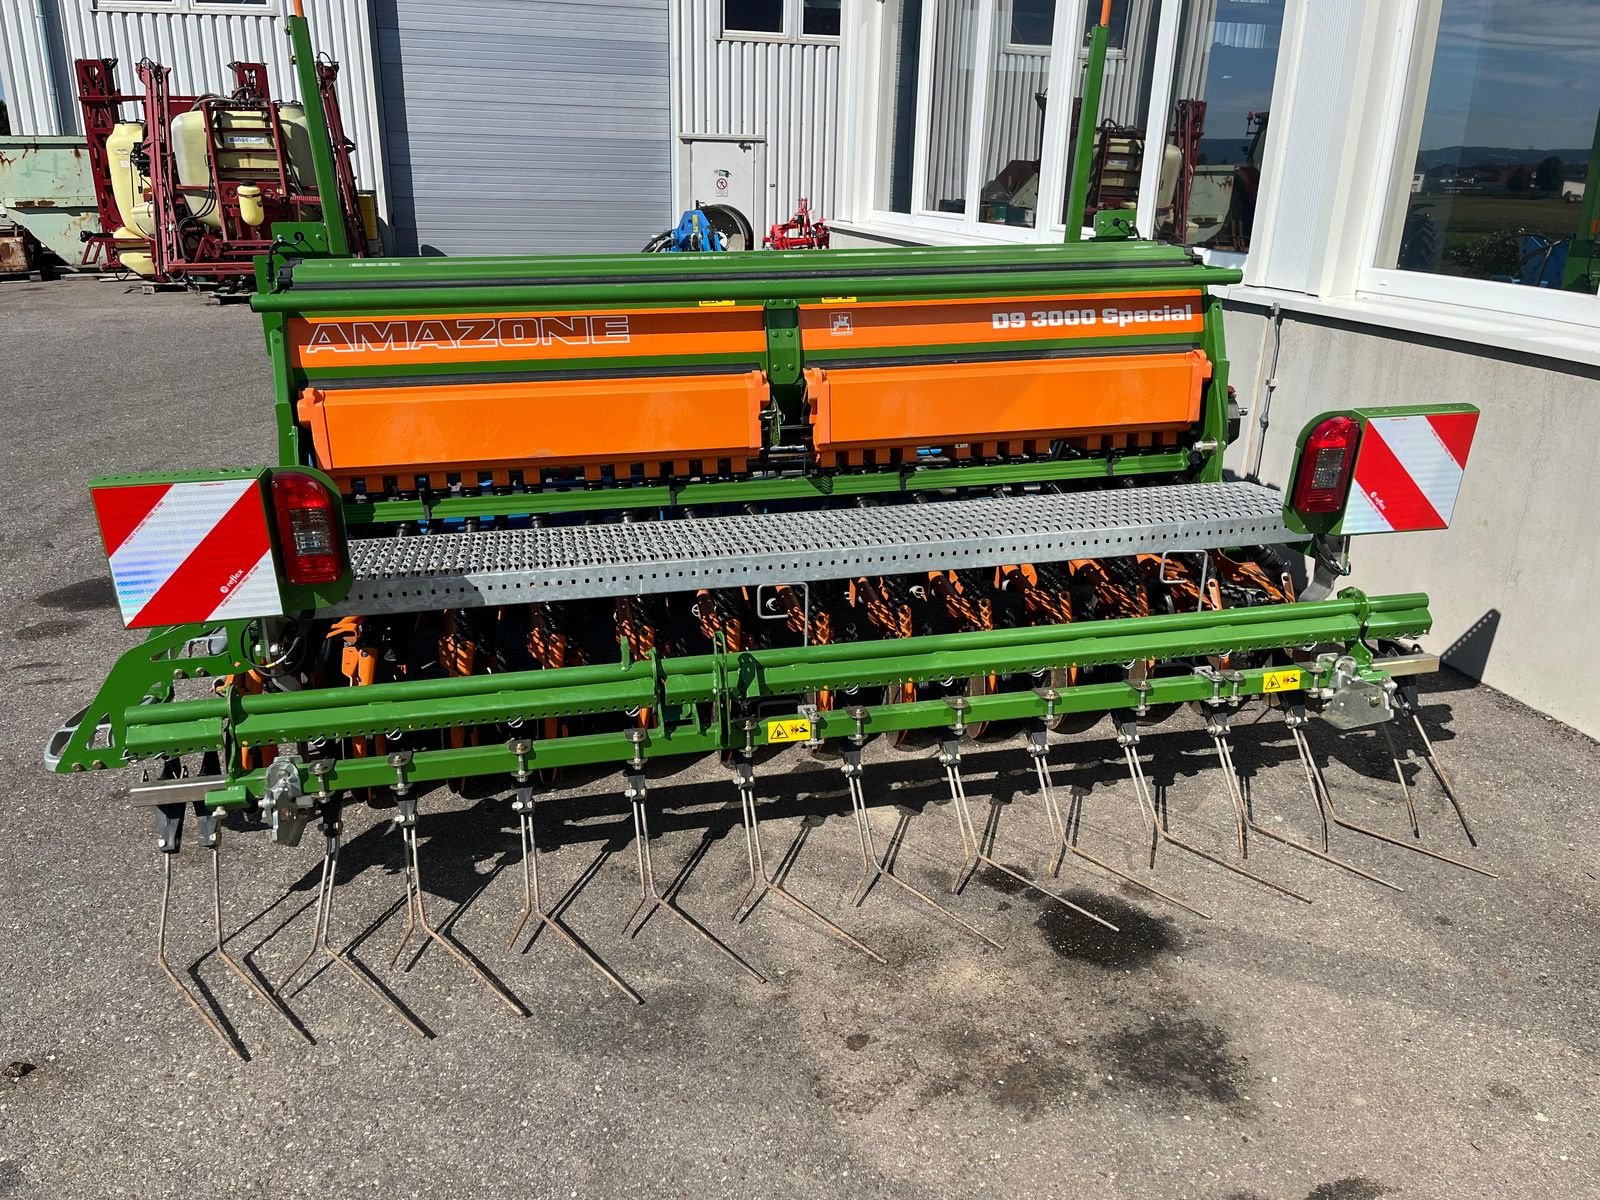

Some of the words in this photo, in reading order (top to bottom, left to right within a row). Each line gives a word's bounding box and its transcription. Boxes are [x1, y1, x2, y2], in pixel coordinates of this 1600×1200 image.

[992, 312, 1026, 329] D9
[1032, 309, 1096, 327] 3000
[1102, 304, 1193, 327] Special
[306, 316, 630, 353] AMAZONE
[227, 569, 244, 587] reflex
